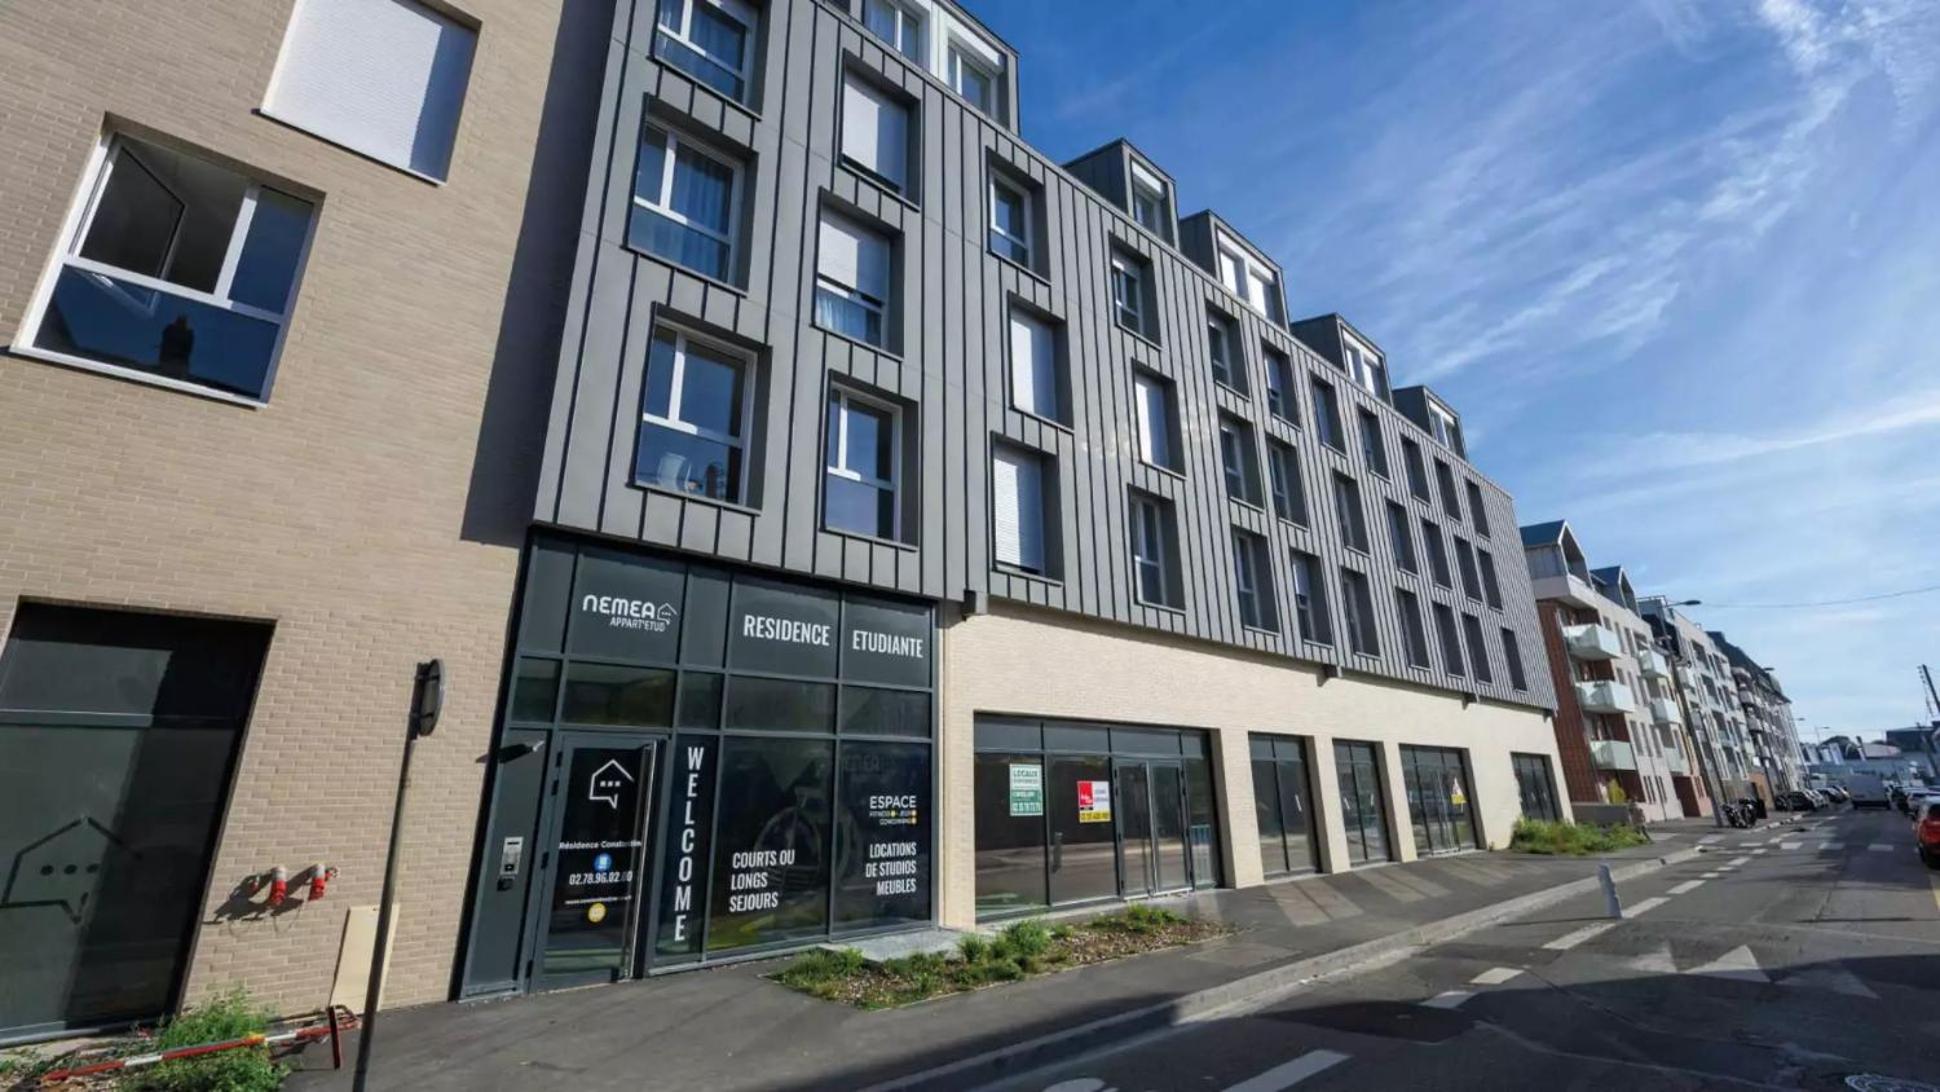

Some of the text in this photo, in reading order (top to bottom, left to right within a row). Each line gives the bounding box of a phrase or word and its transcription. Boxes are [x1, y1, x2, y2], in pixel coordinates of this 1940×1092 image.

[743, 614, 831, 646] RESIDENCE
[852, 629, 924, 658] ETUDIANTE
[869, 795, 917, 809] ESPACE
[674, 746, 704, 942] WELCOME
[869, 841, 917, 859] LOCATIONS
[732, 848, 796, 869] COURTS OU
[865, 860, 917, 878] DE STUDIOS
[731, 871, 769, 891] LONGS
[876, 878, 917, 896] MEUBLES
[728, 891, 779, 912] SEJOURS
